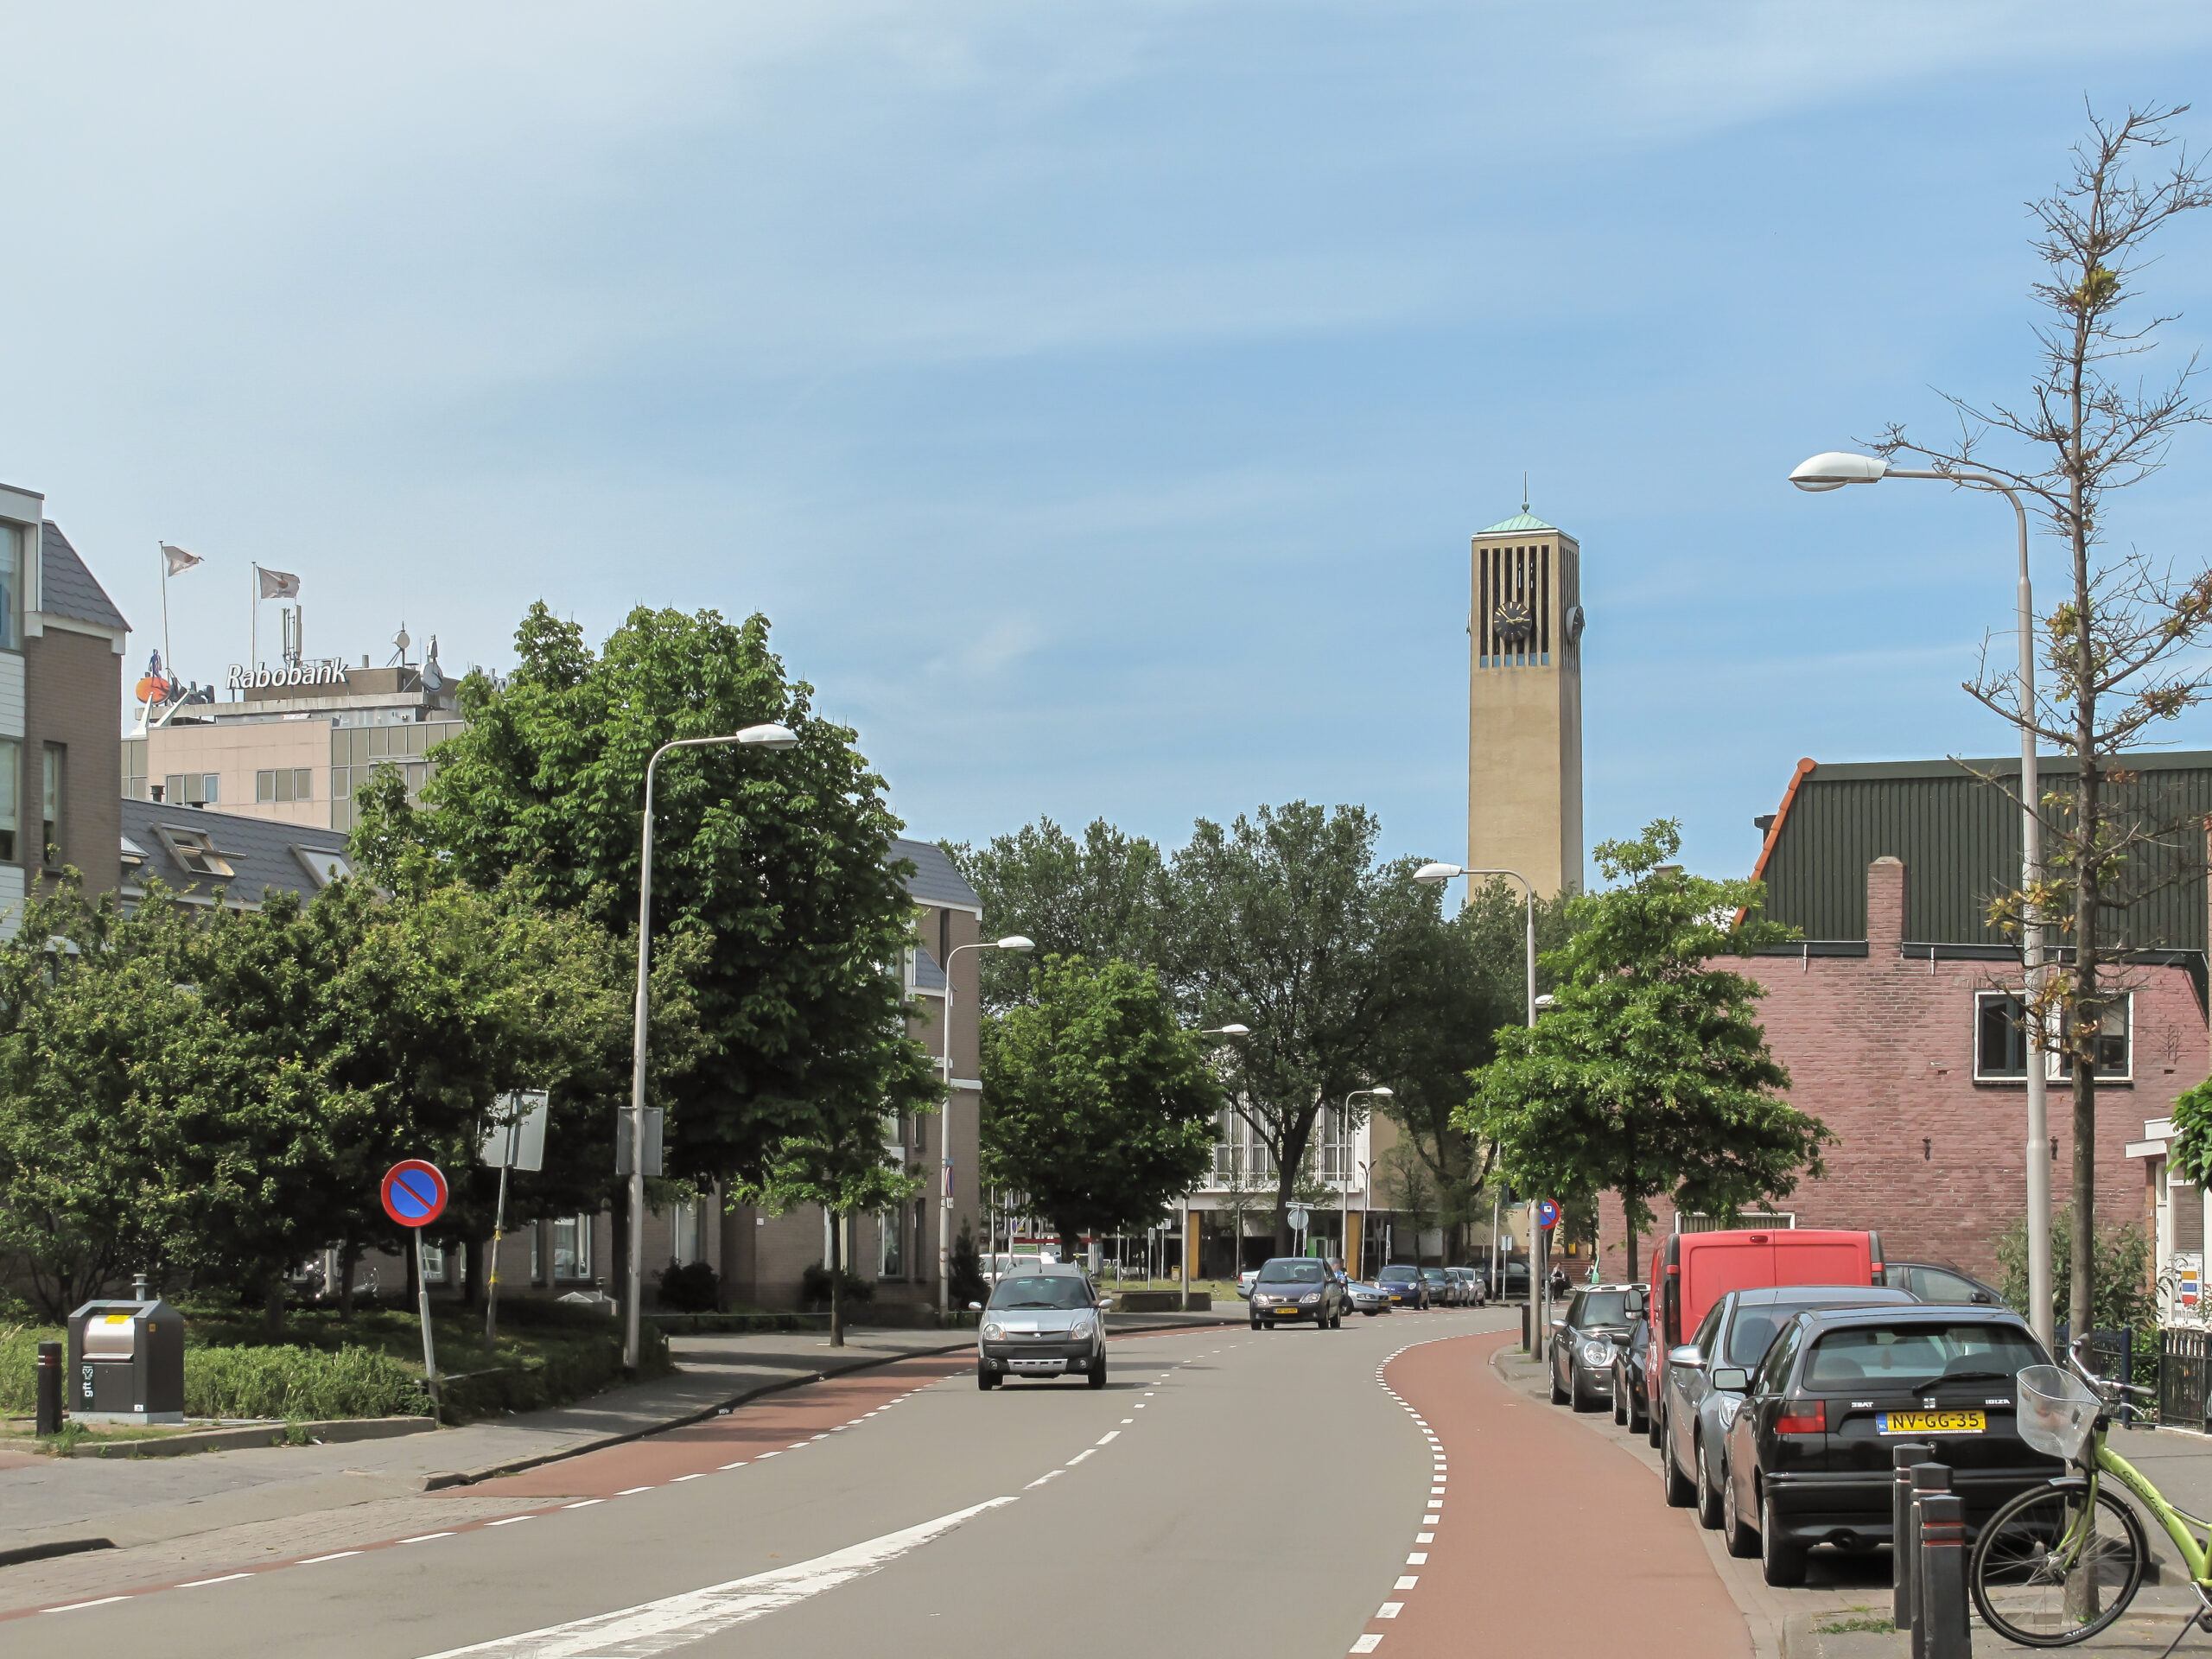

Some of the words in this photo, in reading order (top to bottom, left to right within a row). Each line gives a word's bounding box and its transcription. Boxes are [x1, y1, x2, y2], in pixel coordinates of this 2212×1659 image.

[226, 657, 348, 690] Rabobank
[82, 1382, 93, 1397] gft
[1891, 1413, 1980, 1429] NV-GG-35
